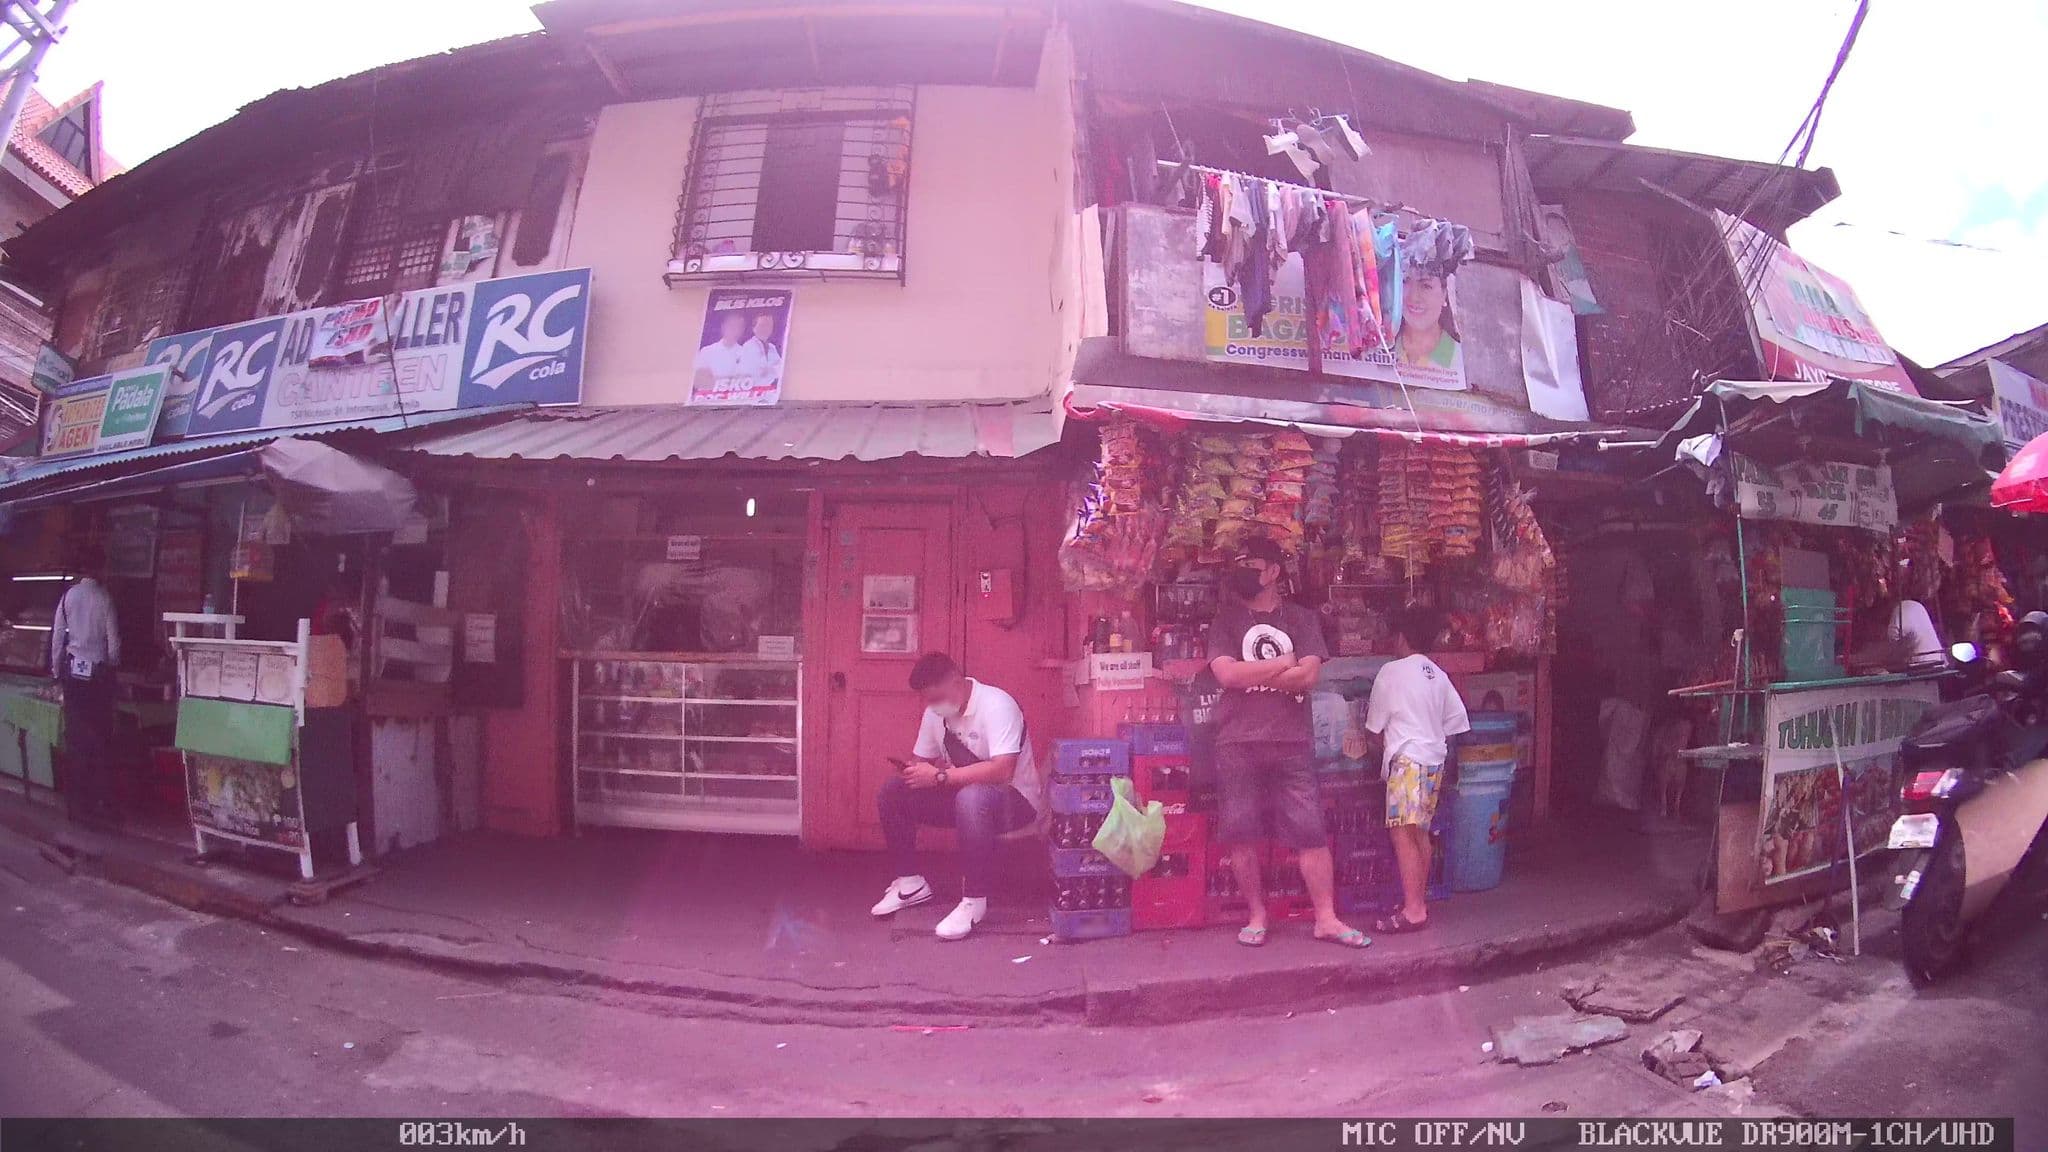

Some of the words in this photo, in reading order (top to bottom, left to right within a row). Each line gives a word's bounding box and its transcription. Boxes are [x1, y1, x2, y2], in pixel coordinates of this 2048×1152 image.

[746, 297, 786, 309] KILOS
[1209, 289, 1231, 305] #1
[472, 284, 582, 377] RC
[197, 331, 277, 412] RC
[277, 353, 448, 408] CANTEEN
[529, 361, 567, 382] cola
[713, 377, 754, 393] ISKO
[112, 383, 154, 413] Padala
[231, 394, 256, 411] cola
[58, 423, 100, 449] AGENT
